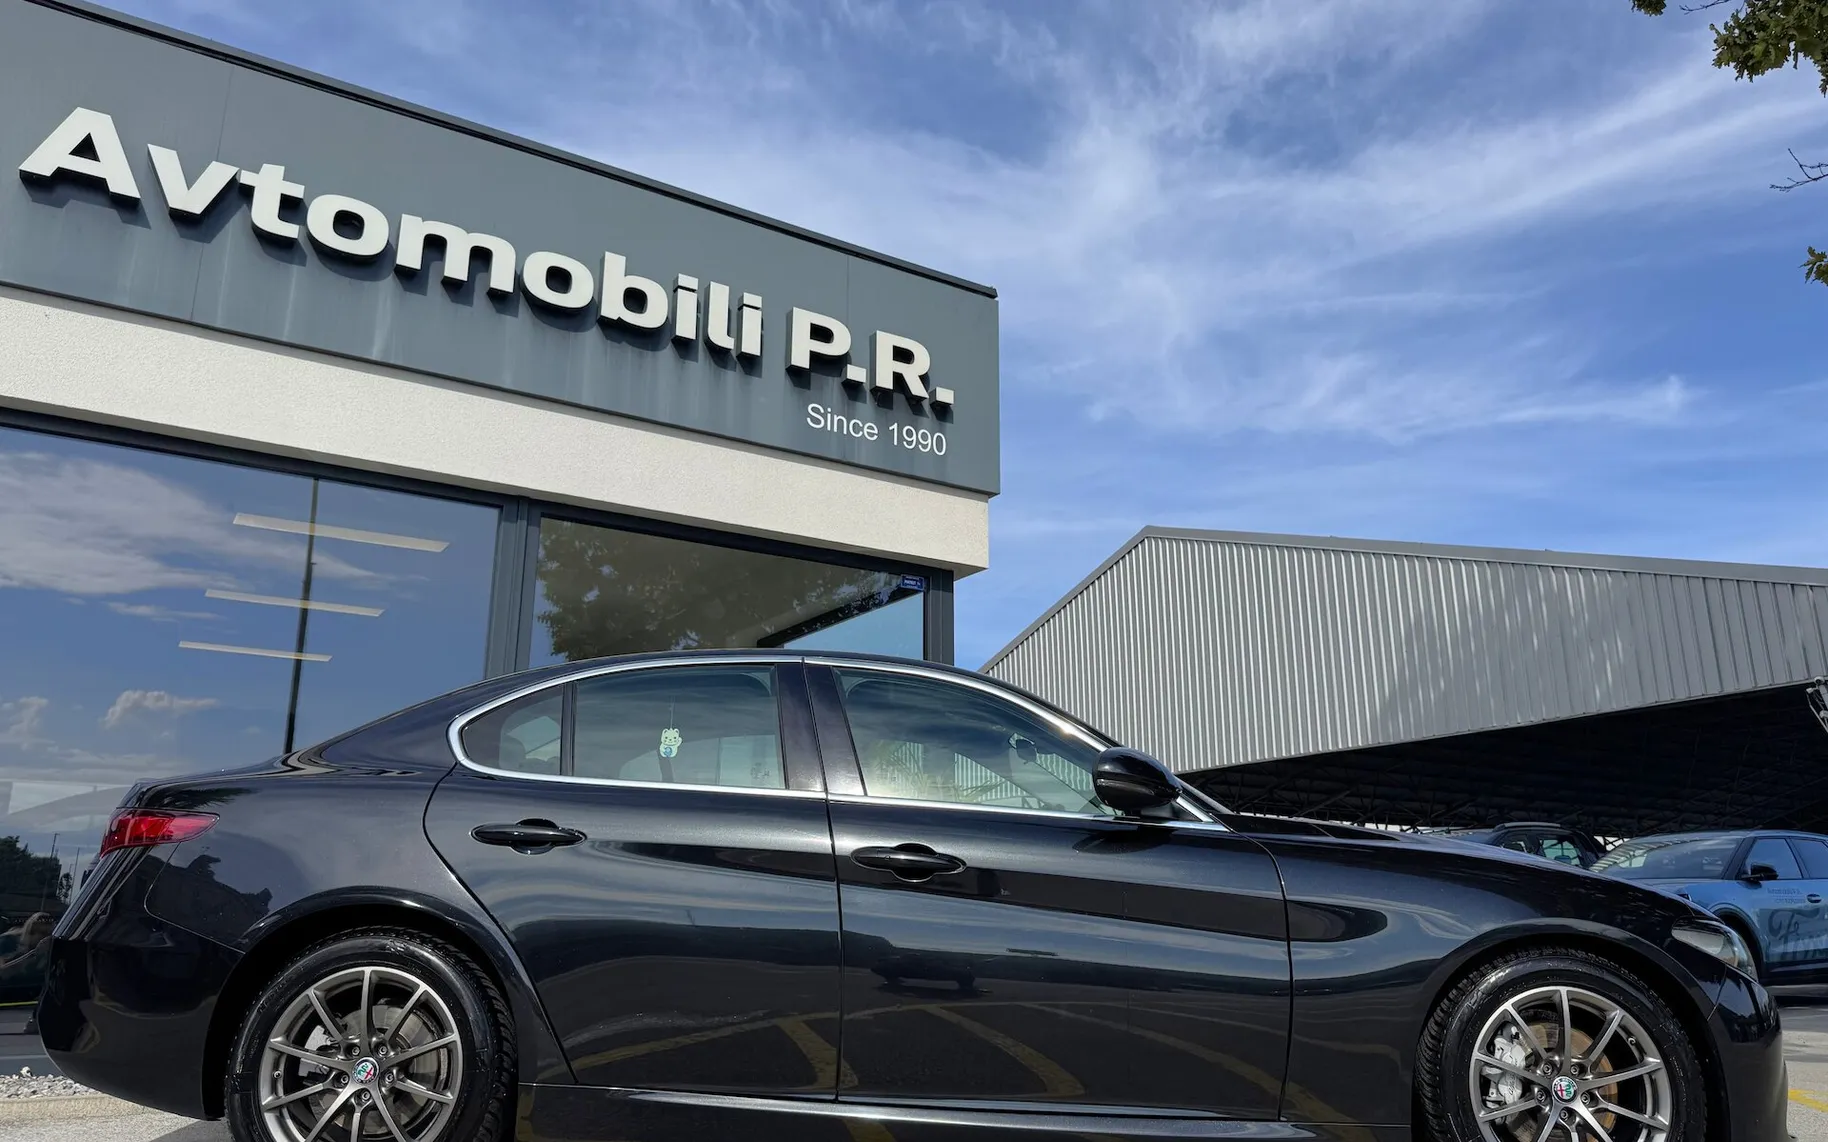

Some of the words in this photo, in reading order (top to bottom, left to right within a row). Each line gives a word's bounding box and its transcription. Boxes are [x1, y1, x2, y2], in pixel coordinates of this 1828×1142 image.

[19, 107, 763, 358] Avtomobili
[788, 306, 954, 406] P.R.
[806, 403, 879, 441] Since
[888, 422, 947, 456] 1990
